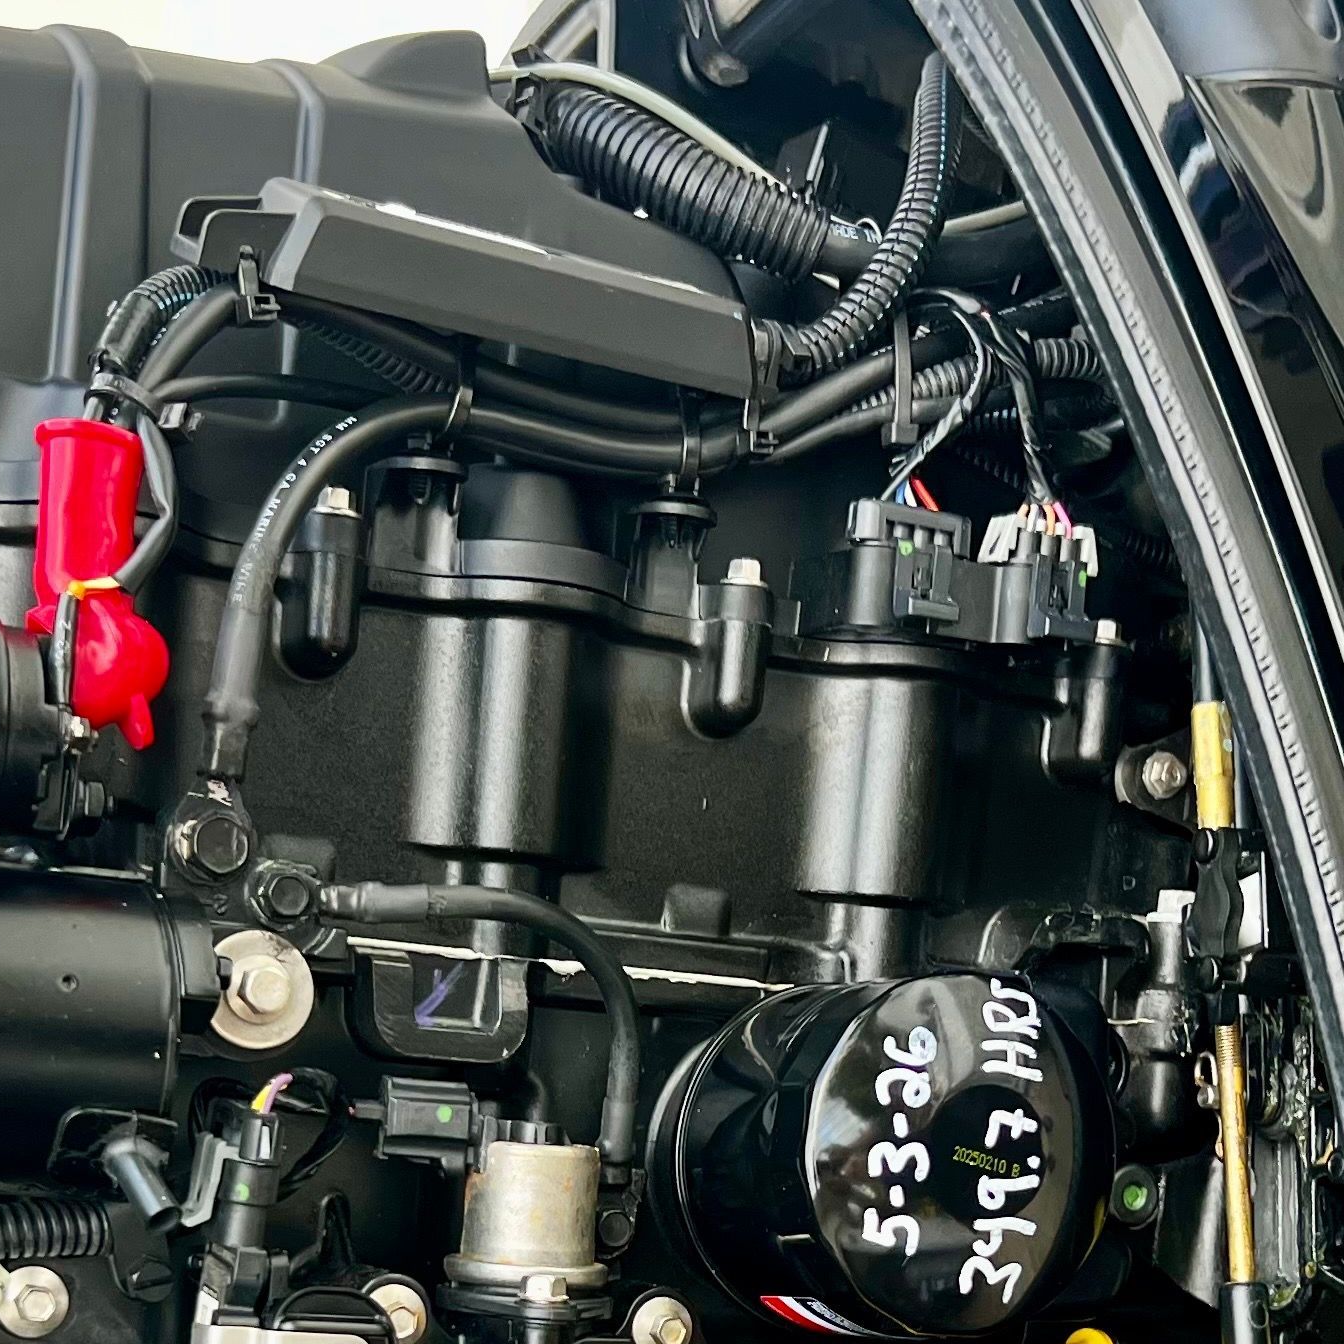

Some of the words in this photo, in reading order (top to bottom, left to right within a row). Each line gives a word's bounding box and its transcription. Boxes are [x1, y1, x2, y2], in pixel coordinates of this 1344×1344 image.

[309, 433, 333, 454] SGT
[297, 458, 307, 467] 4
[279, 472, 297, 489] GA
[980, 978, 1043, 1082] HRS
[862, 1025, 937, 1257] 5-3-26
[953, 1145, 1006, 1174] 20250210
[959, 1108, 1040, 1304] 349.7
